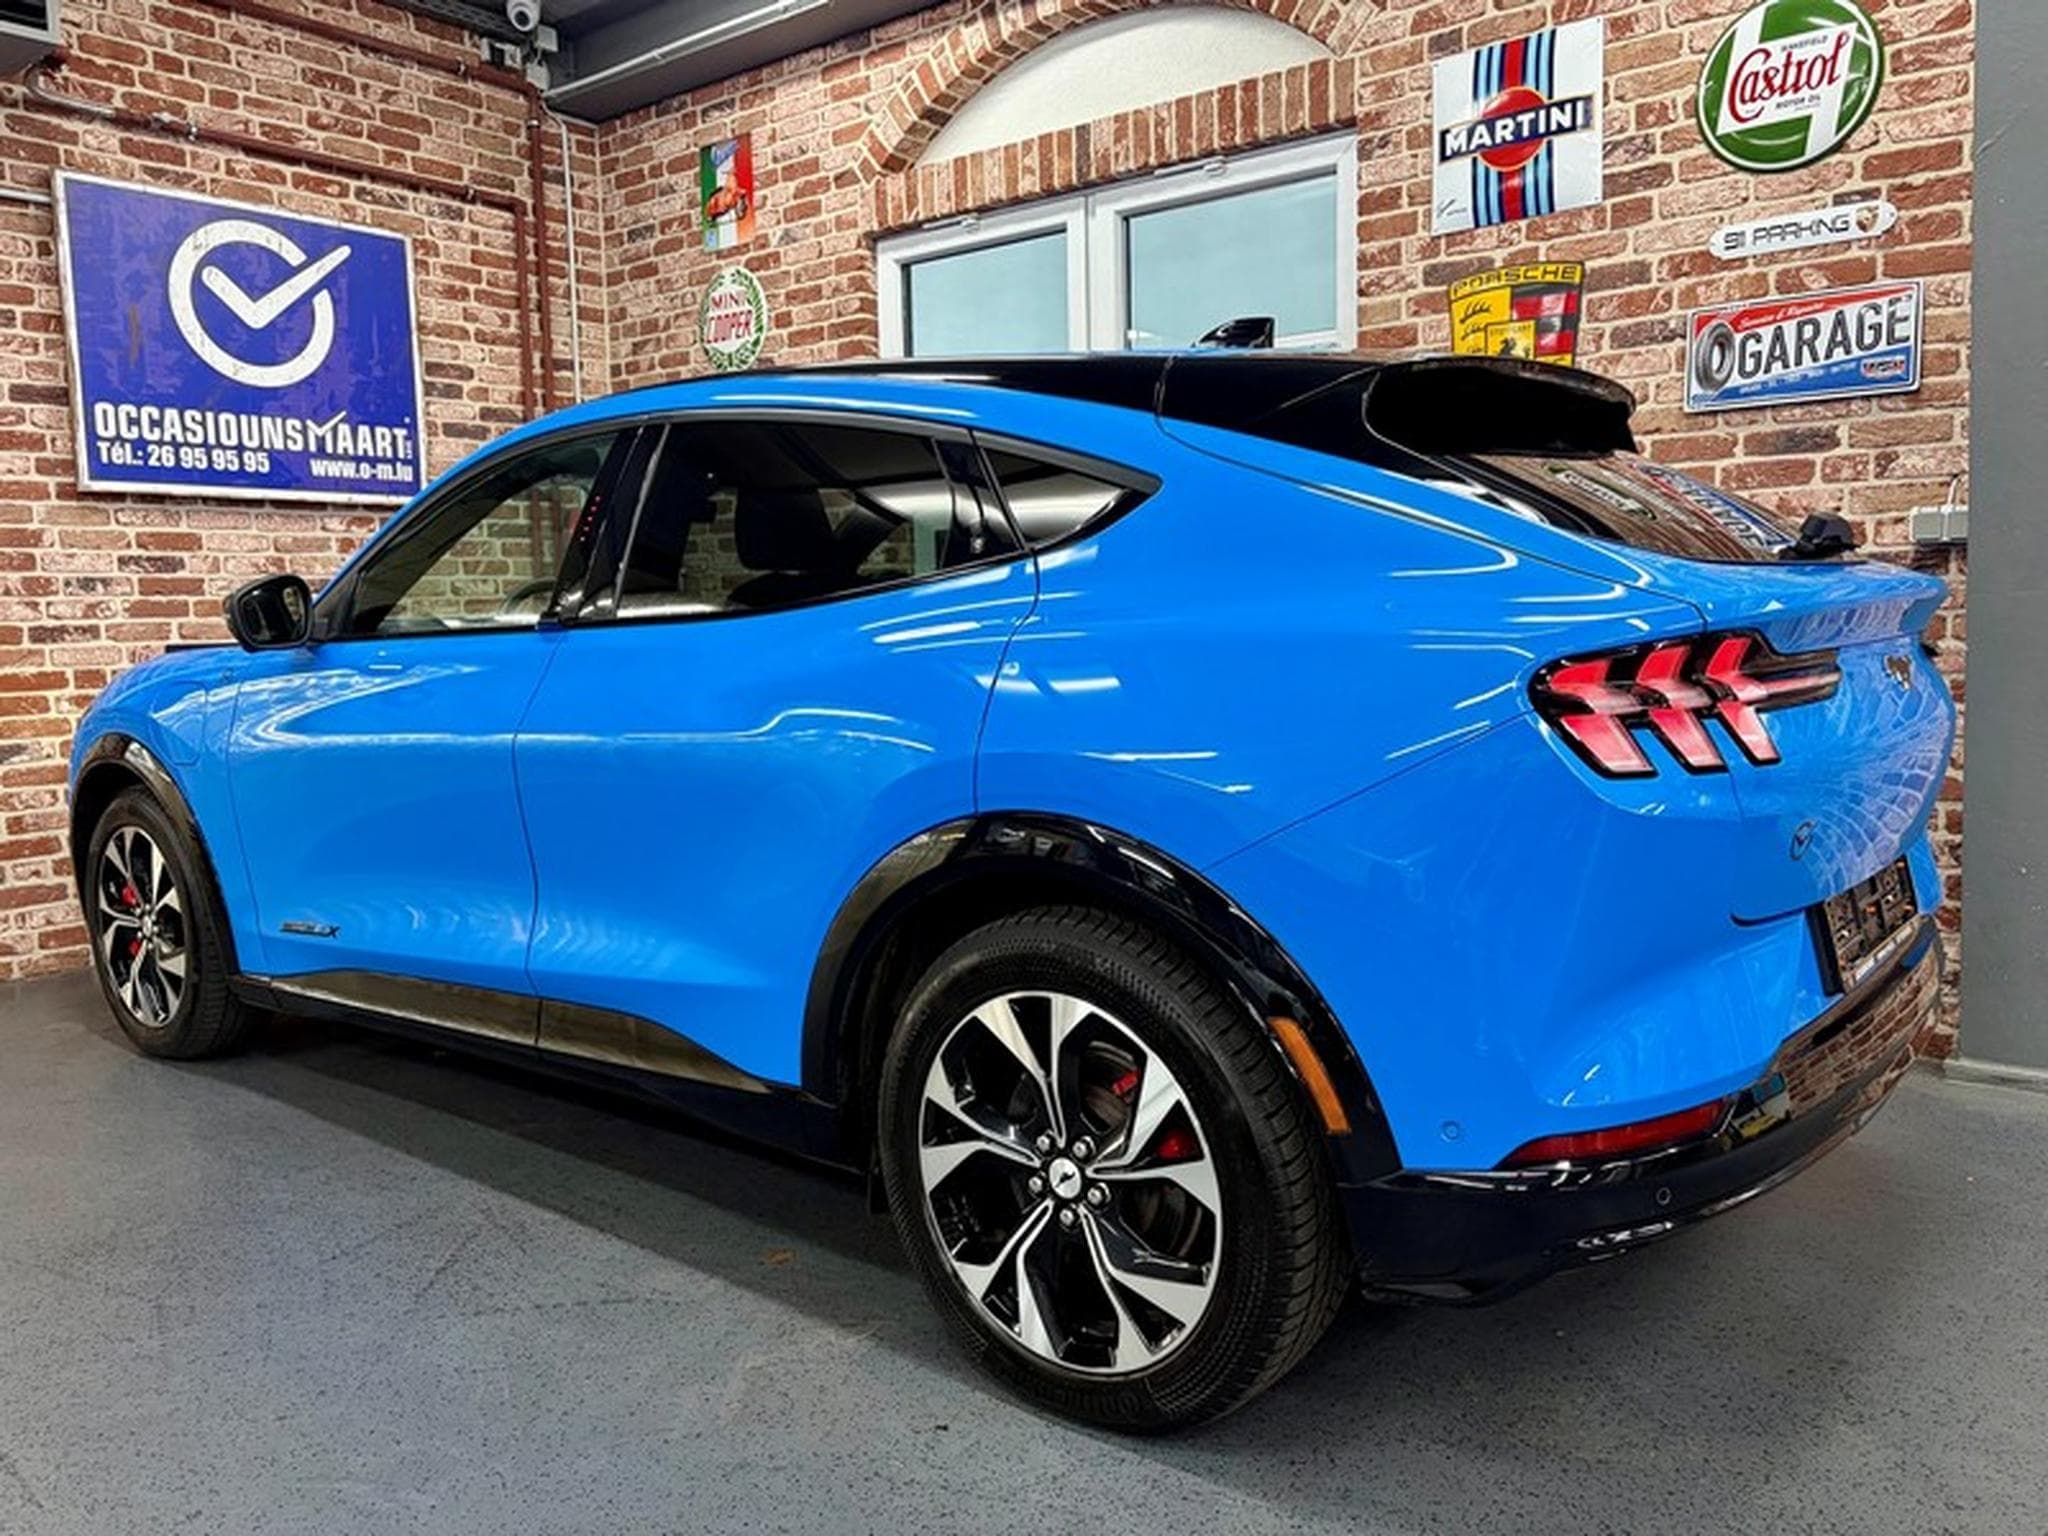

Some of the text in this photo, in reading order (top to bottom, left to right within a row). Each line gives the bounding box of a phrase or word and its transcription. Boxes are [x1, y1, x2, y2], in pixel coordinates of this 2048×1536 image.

[1728, 31, 1850, 123] Castrol
[1445, 101, 1583, 157] MARTINI
[1753, 214, 1850, 246] PARKING
[1454, 266, 1577, 297] PORSCHE
[1737, 293, 1912, 380] GARAGE
[94, 401, 408, 460] OCCASIOUNSMAART
[147, 444, 176, 468] 26
[180, 446, 209, 470] 95
[212, 448, 240, 472] 95
[243, 451, 271, 474] 95
[310, 458, 414, 482] www.o-m.lu
